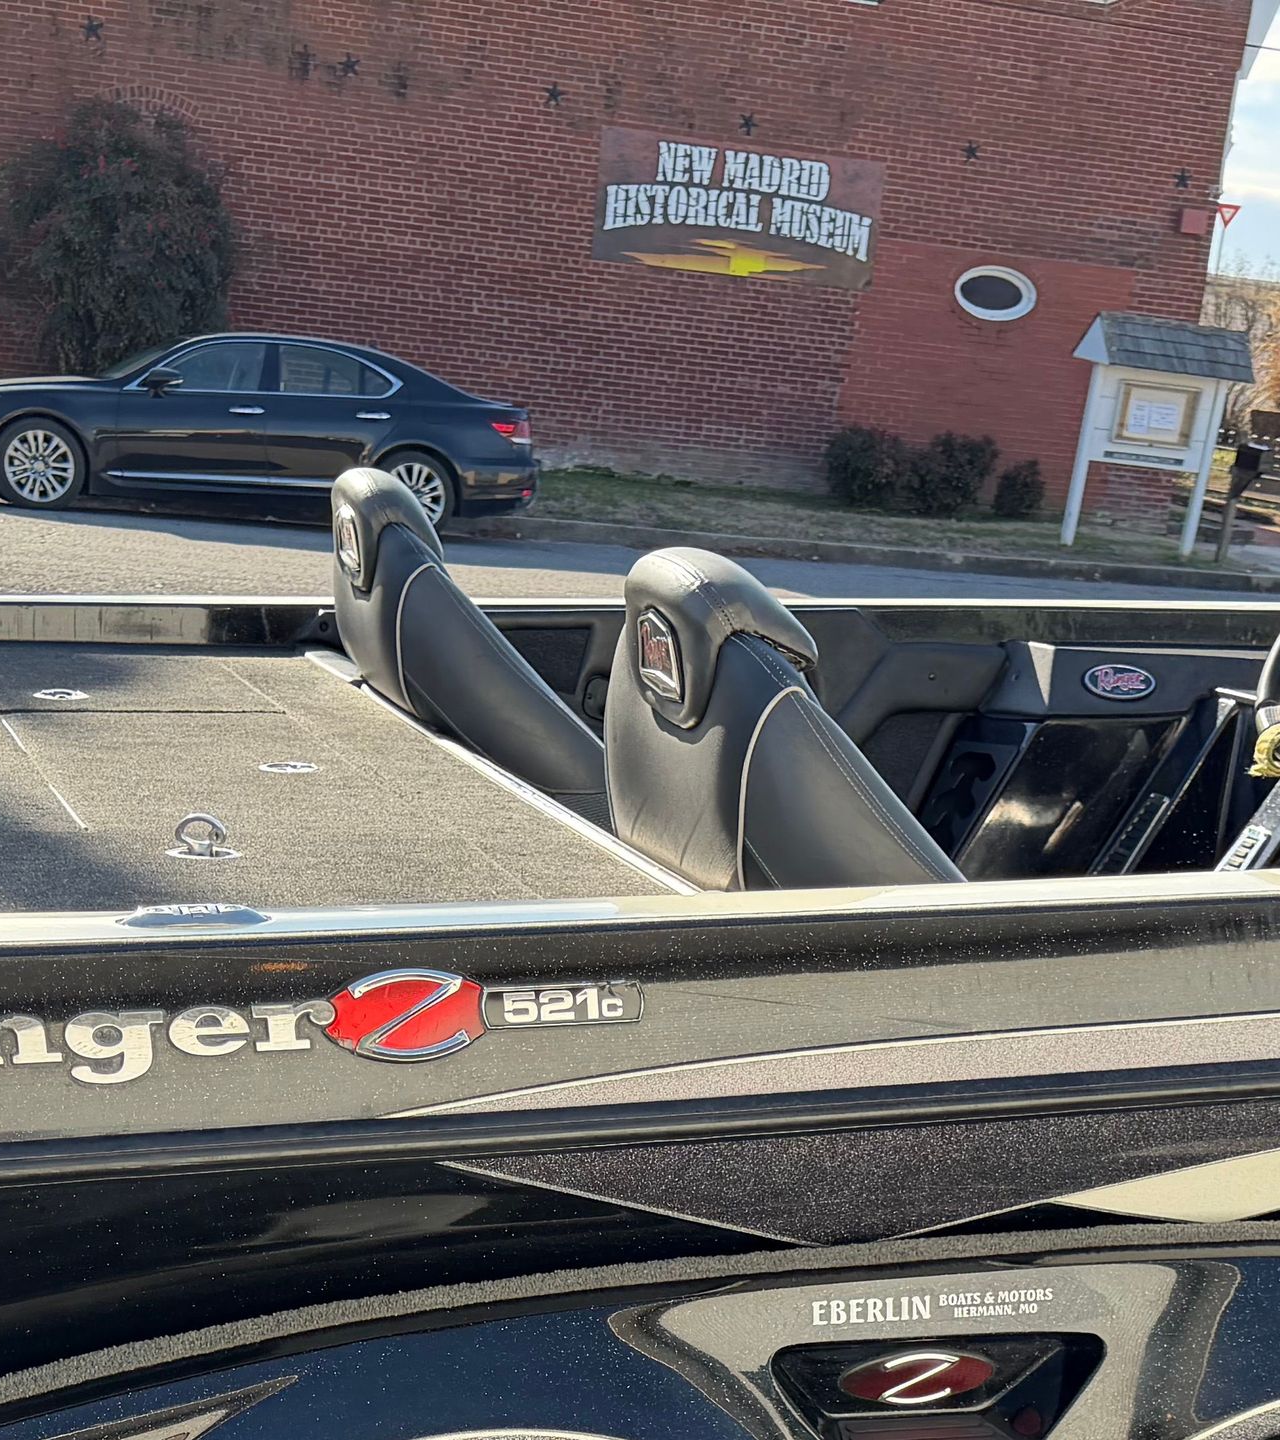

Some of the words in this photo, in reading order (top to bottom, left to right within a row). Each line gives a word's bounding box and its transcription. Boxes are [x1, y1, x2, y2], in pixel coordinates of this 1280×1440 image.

[655, 140, 718, 186] NEW
[723, 149, 831, 201] MADRID
[603, 183, 764, 233] HISTORICAL
[768, 197, 873, 262] MUSEUM
[811, 1294, 932, 1326] EBERLIN
[938, 1292, 981, 1307] BOATS
[984, 1291, 995, 1304] &
[997, 1287, 1054, 1303] MOTORS
[953, 1304, 1016, 1319] HERMANN,
[1018, 1302, 1038, 1314] MO
